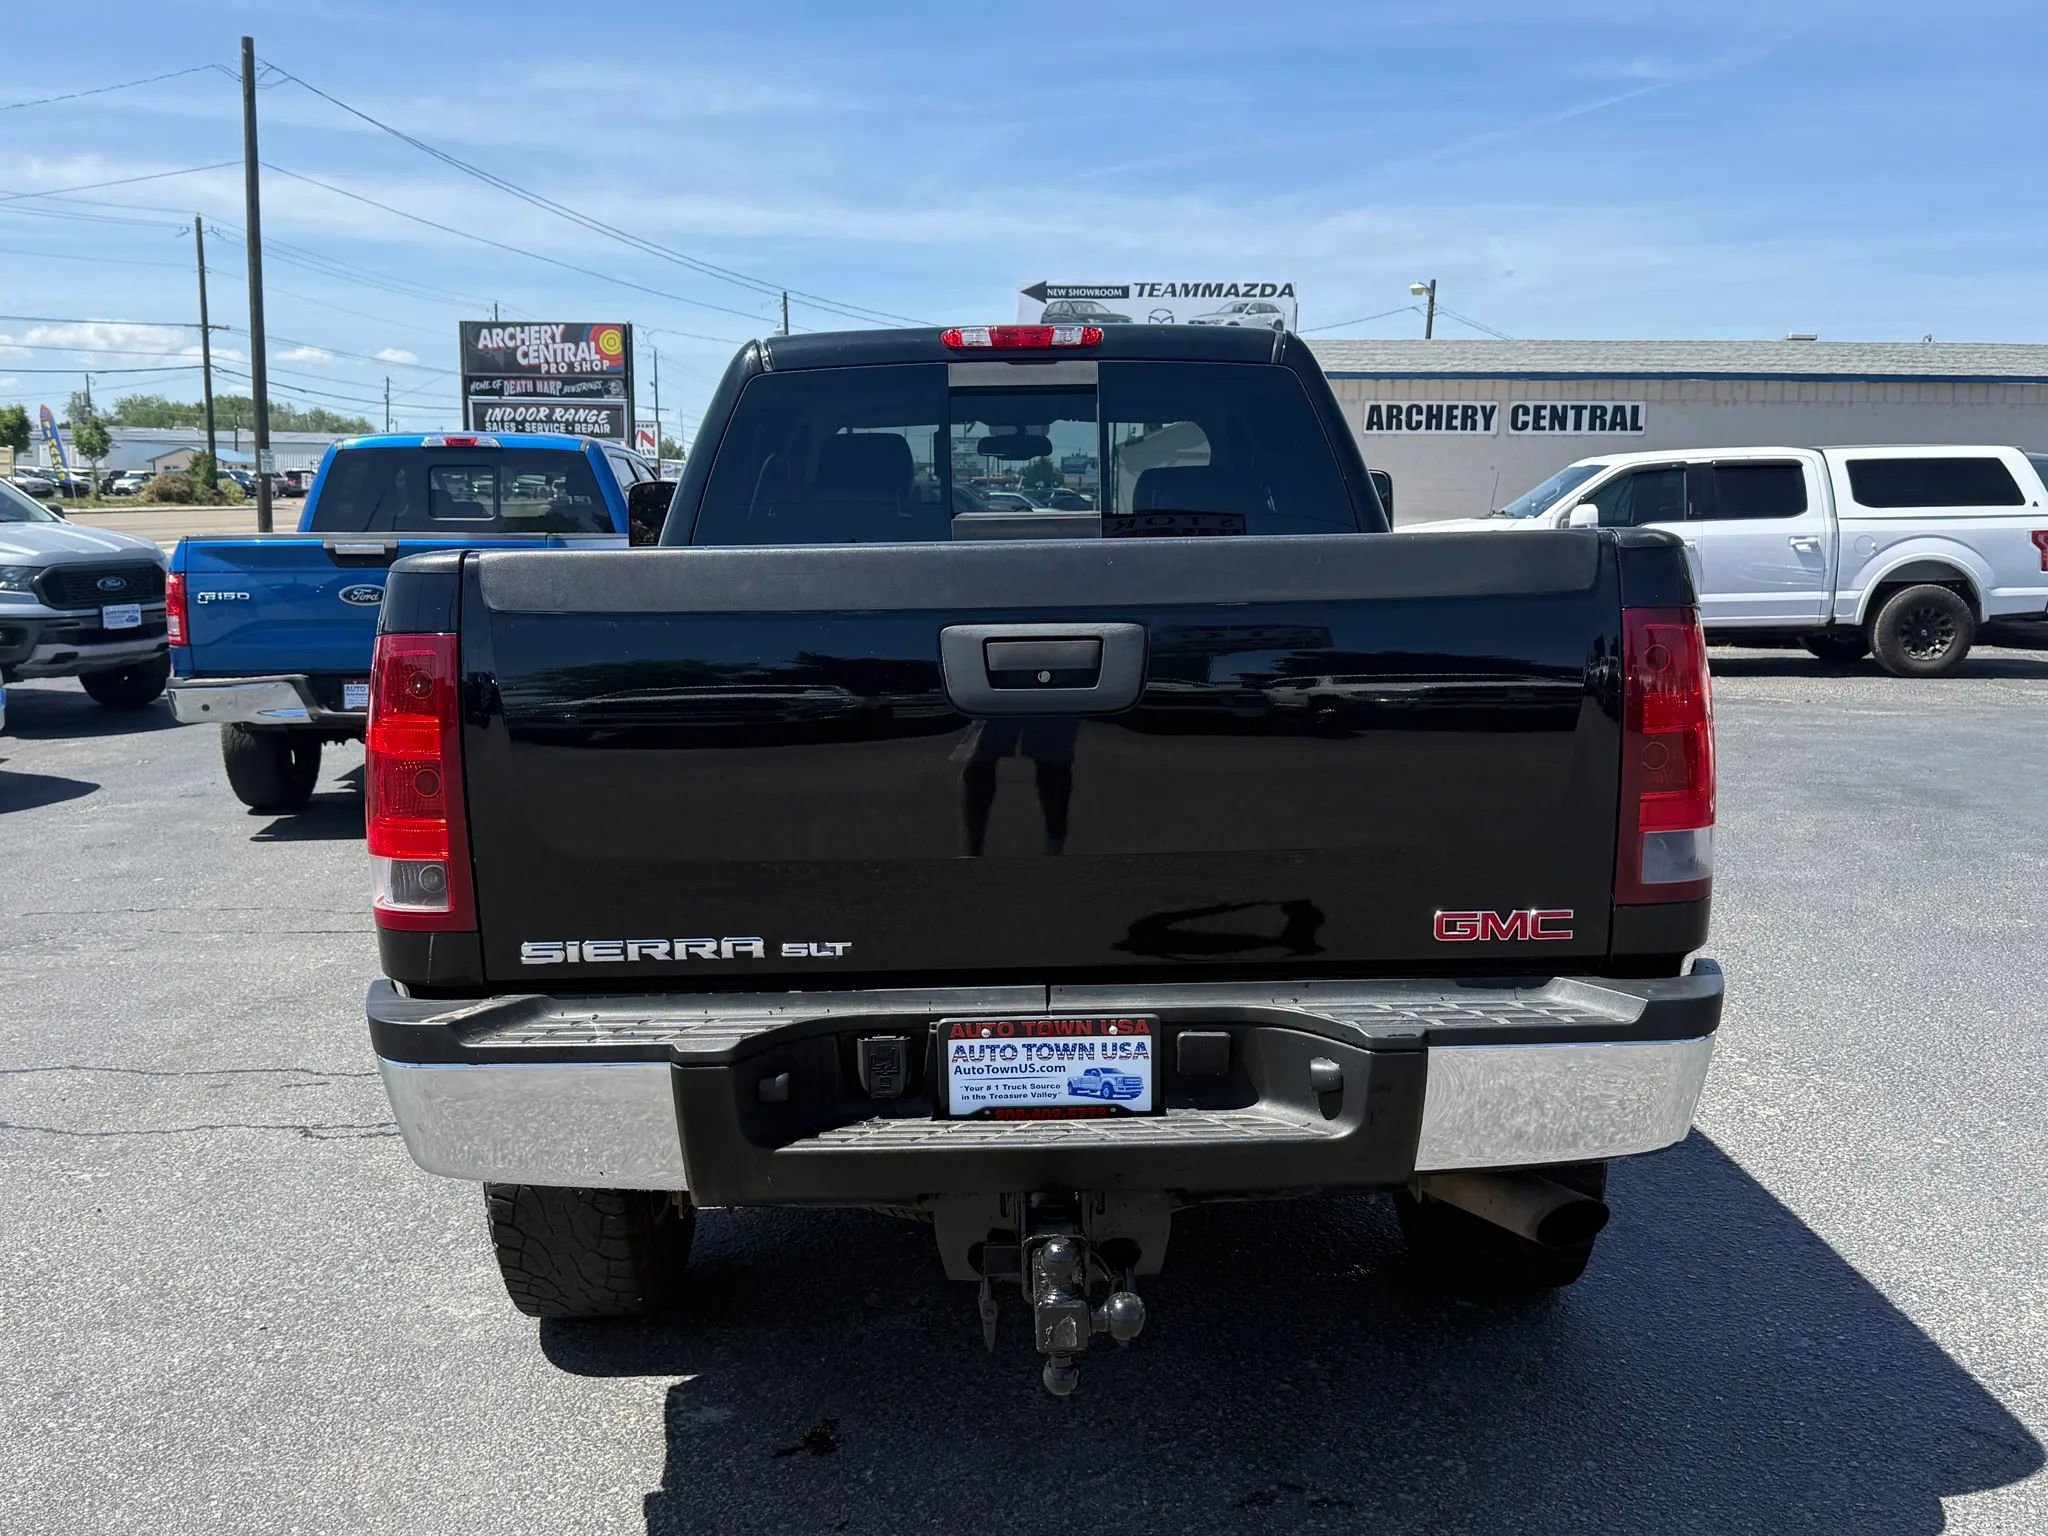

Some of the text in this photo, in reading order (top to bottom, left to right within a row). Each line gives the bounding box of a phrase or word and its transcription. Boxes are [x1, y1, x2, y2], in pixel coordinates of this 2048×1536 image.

[1047, 288, 1123, 297] NEW SHOWROOM
[478, 324, 565, 349] ARCHERY
[517, 342, 601, 366] CENTRAL
[541, 360, 610, 374] PRO SHOP
[470, 381, 491, 392] HOME
[492, 380, 503, 389] OF
[503, 379, 533, 395] DEATH
[484, 407, 611, 424] INDOOR RANGE
[1365, 404, 1644, 432] ARCHERY CENTRAL
[485, 422, 611, 434] SALES SERVICE REPAIR
[350, 588, 380, 601] Ford
[1433, 909, 1574, 941] GMC
[521, 936, 853, 964] SIERRA SLT
[950, 1019, 1150, 1038] AUTO TOWN USA
[951, 1041, 1150, 1063] AUTO TOWN USA
[953, 1063, 1066, 1076] AutoTownUS.com
[1002, 1083, 1028, 1091] Truck
